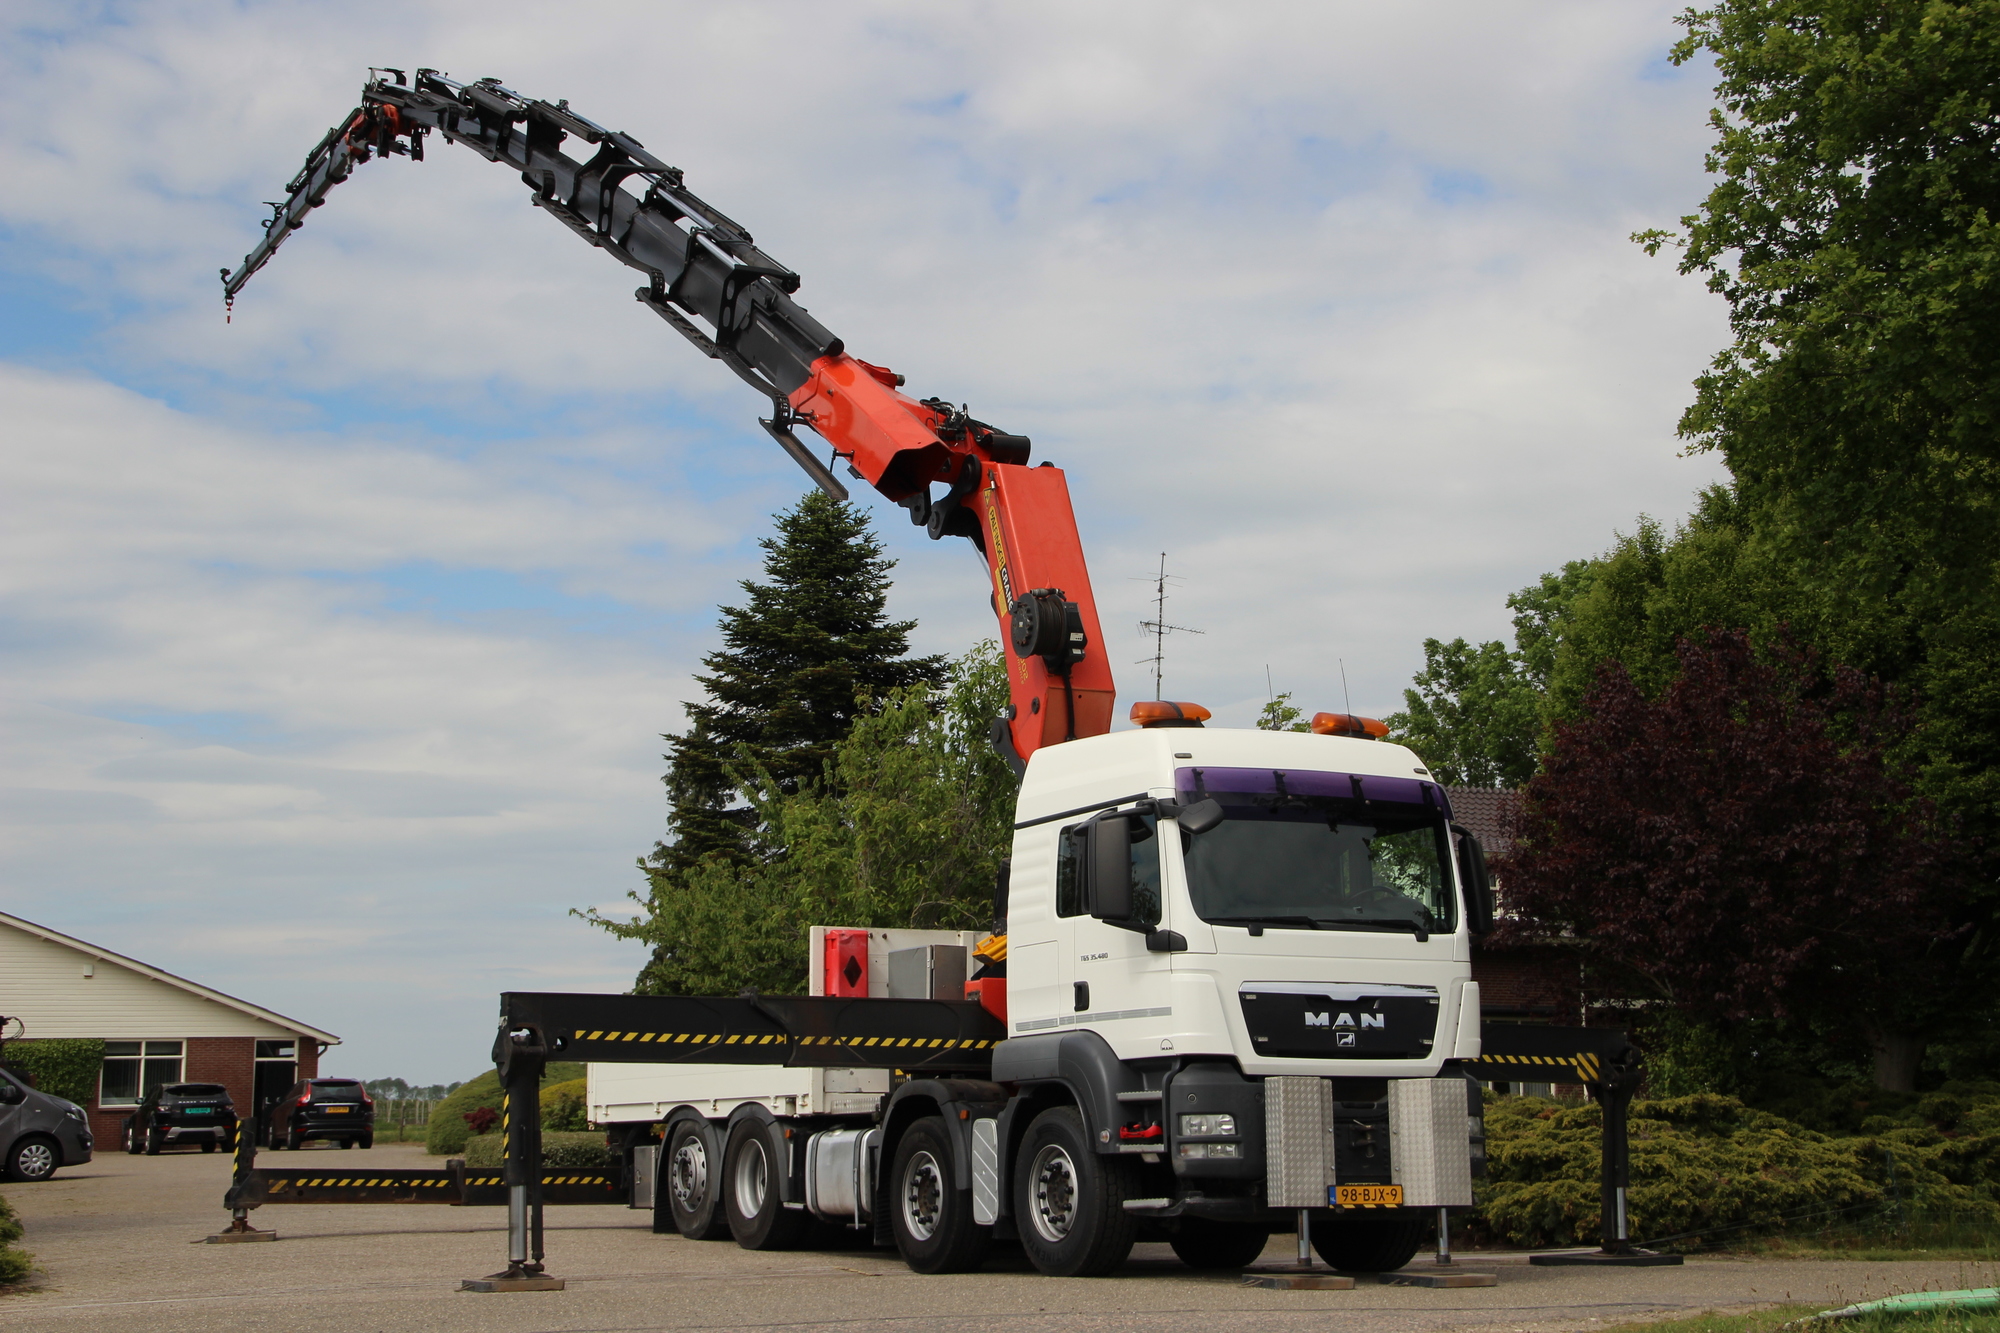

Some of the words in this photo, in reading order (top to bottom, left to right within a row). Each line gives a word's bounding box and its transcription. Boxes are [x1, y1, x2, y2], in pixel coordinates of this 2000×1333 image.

[988, 508, 1006, 568] PALFINGER
[1001, 567, 1014, 612] CRANE
[1090, 952, 1109, 961] 35.480
[1304, 1011, 1385, 1031] MAN
[1341, 1188, 1398, 1202] 98-BJX-9
